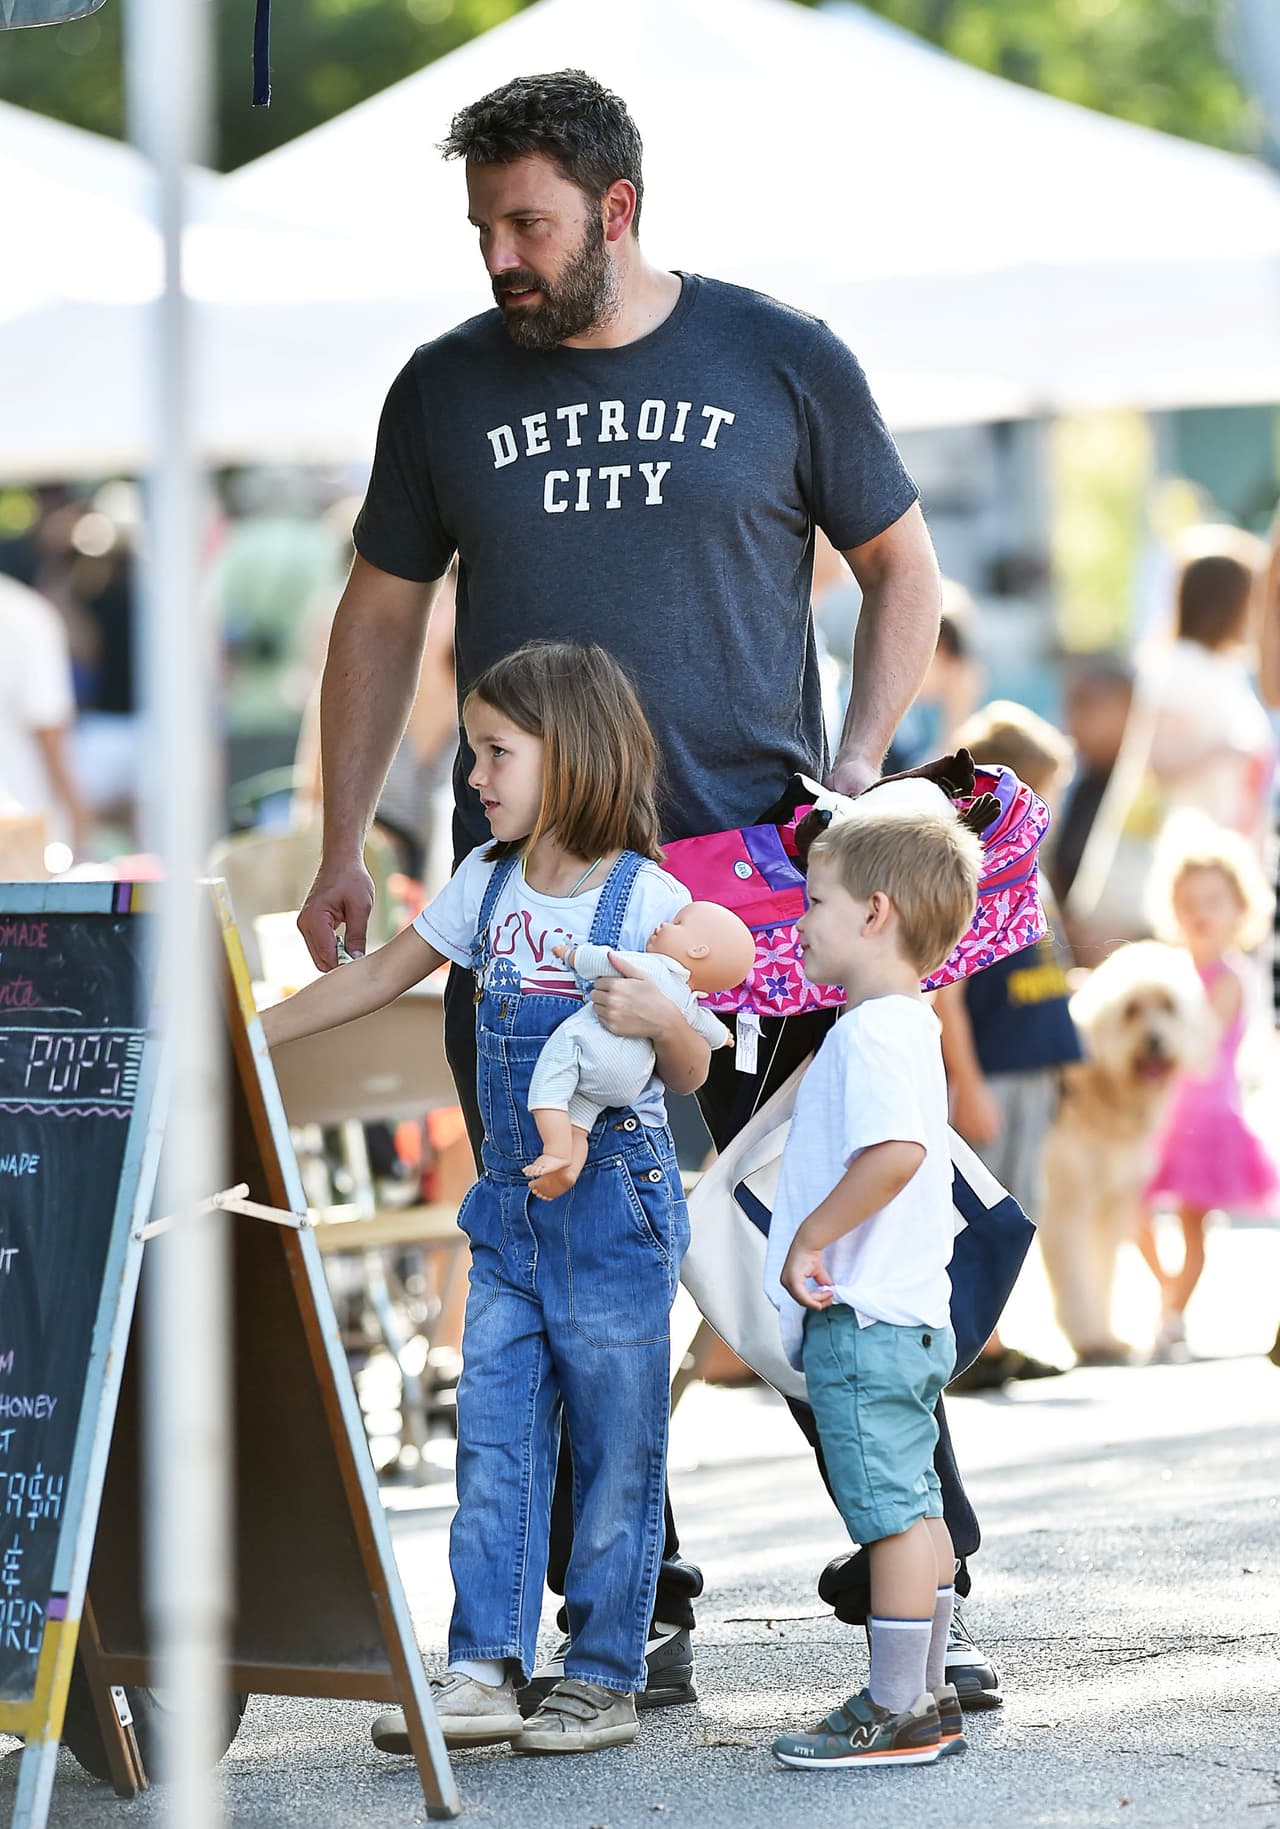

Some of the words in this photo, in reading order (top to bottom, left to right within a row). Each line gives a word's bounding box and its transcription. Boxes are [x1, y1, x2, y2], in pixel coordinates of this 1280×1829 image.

[486, 399, 736, 469] DETROIT
[543, 461, 672, 513] CITY
[24, 1034, 125, 1097] POPS
